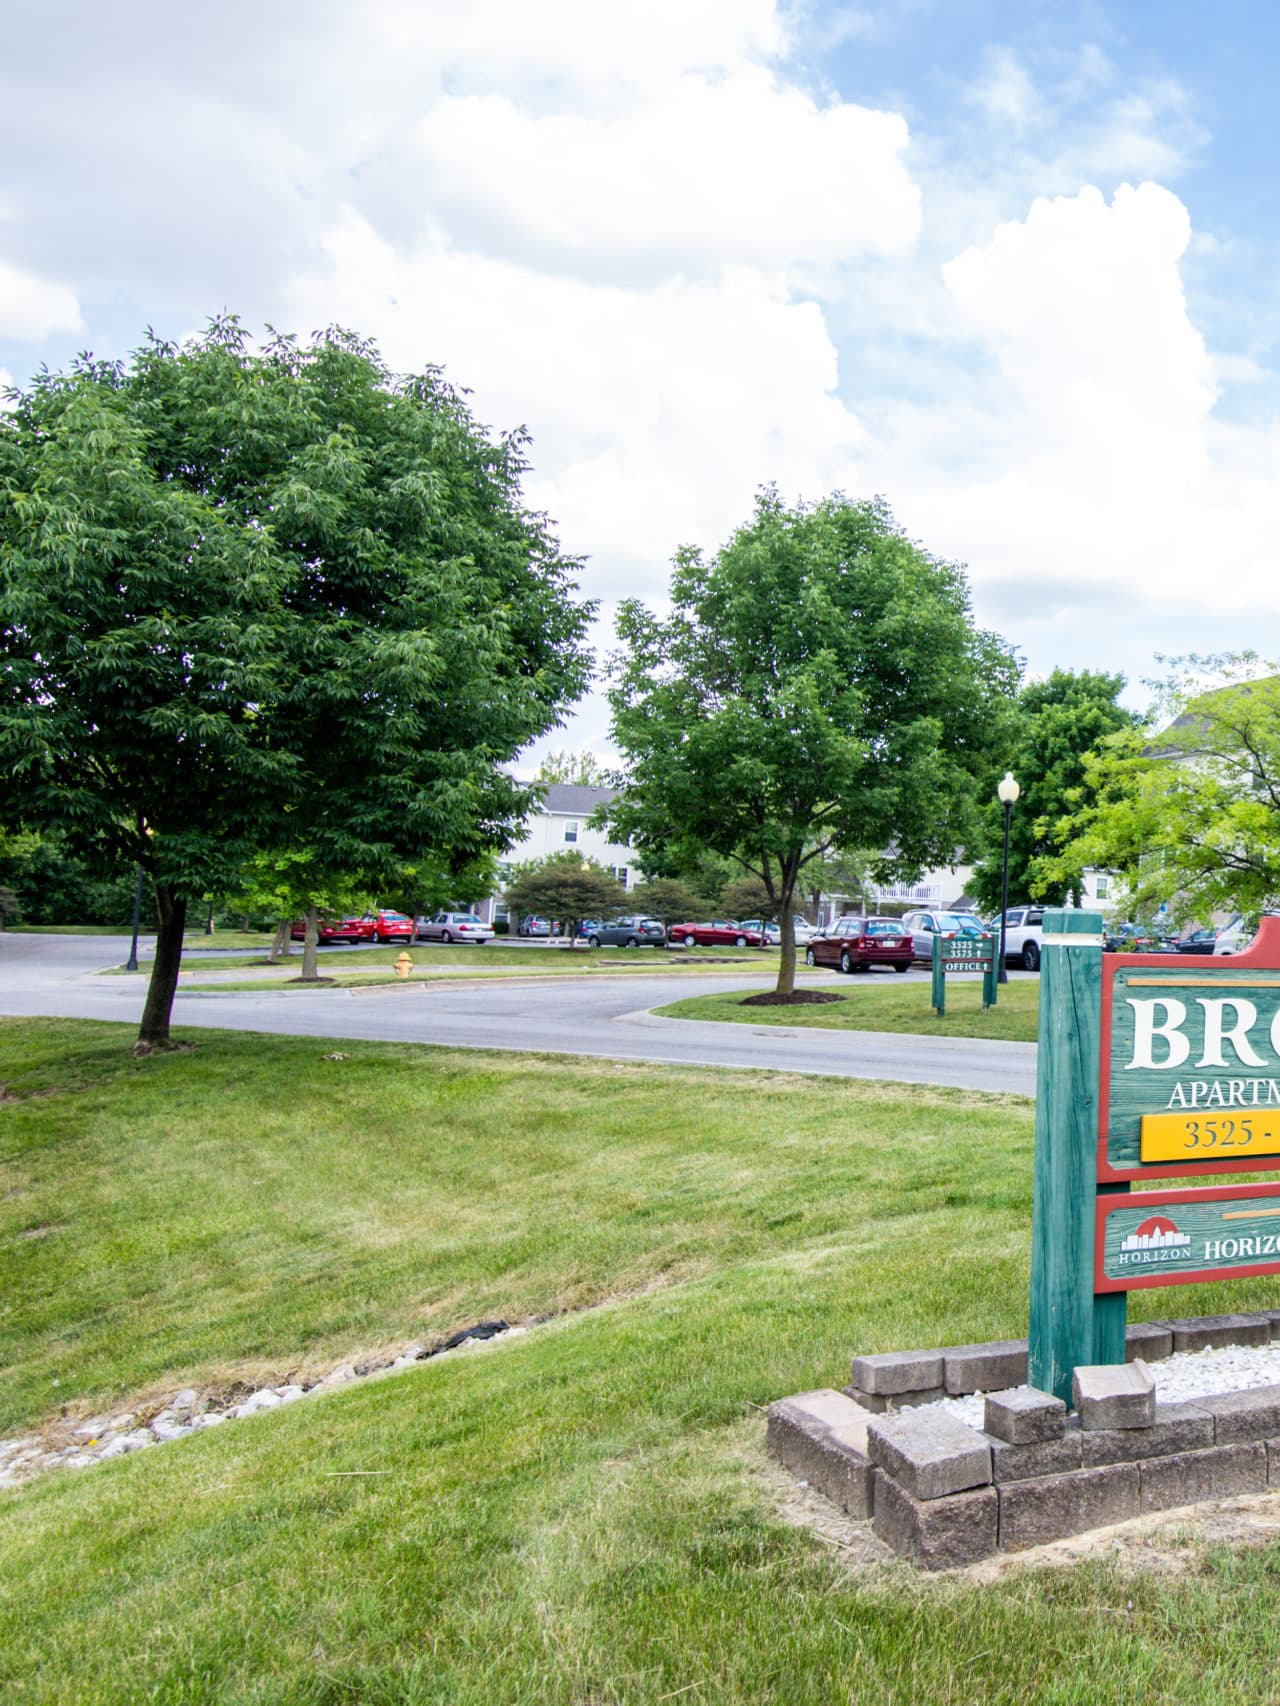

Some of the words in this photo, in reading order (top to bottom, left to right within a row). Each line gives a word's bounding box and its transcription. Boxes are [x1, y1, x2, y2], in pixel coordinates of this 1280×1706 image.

[951, 950, 972, 958] 3575
[945, 962, 981, 971] OFFICE
[1184, 1120, 1253, 1149] 3525
[1118, 1248, 1191, 1264] HORIZON
